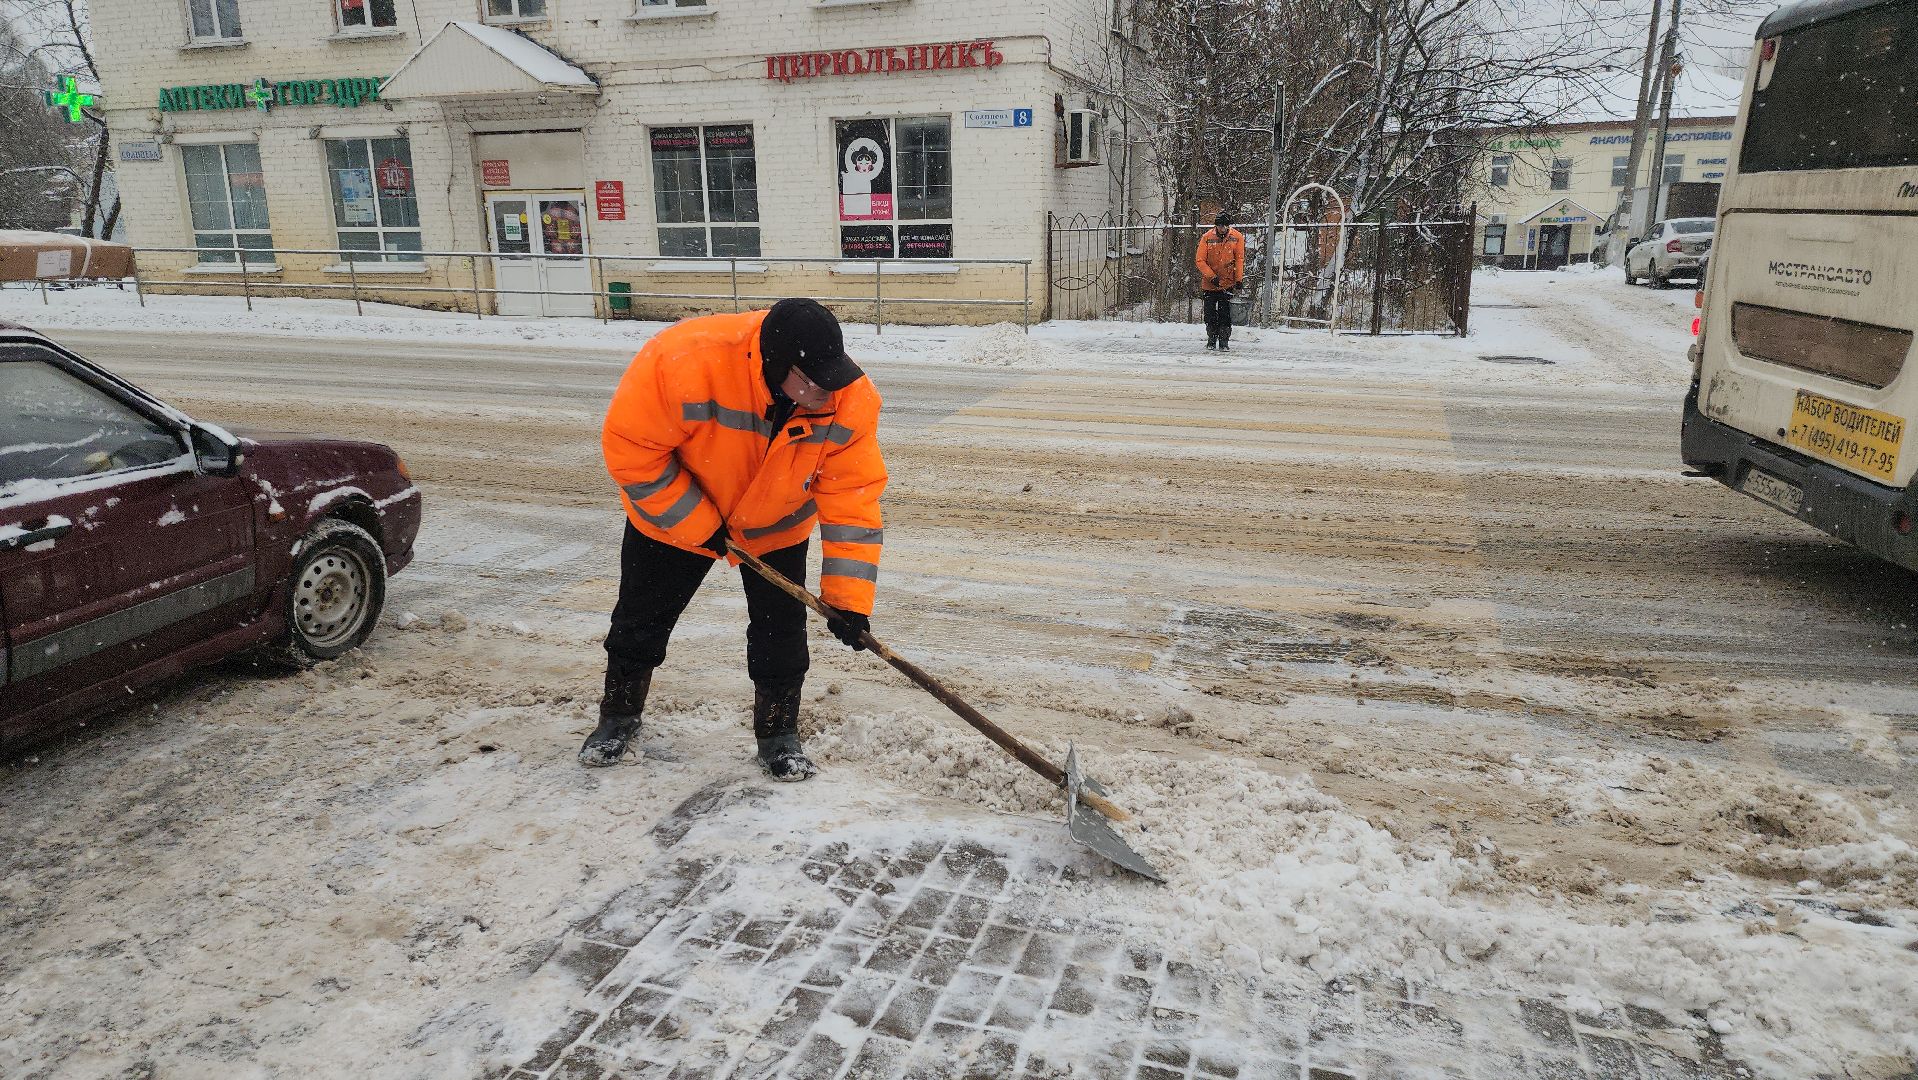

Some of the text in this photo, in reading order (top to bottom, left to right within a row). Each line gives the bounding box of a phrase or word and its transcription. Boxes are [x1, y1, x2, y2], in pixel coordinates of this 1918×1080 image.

[765, 41, 1003, 83] ЦИРЮЛЬНИКЪ
[159, 75, 390, 112] АПТЕКИ ГОРЗДРА
[1018, 111, 1027, 125] 8
[1590, 135, 1633, 145] АНАЛИ
[1768, 260, 1872, 285] МОСТРАНСАВТО
[1796, 393, 1901, 443] НАБОР ВОДИТЕЛЕЙ
[1808, 426, 1836, 454] (495)
[1836, 438, 1895, 473] 419-17-95
